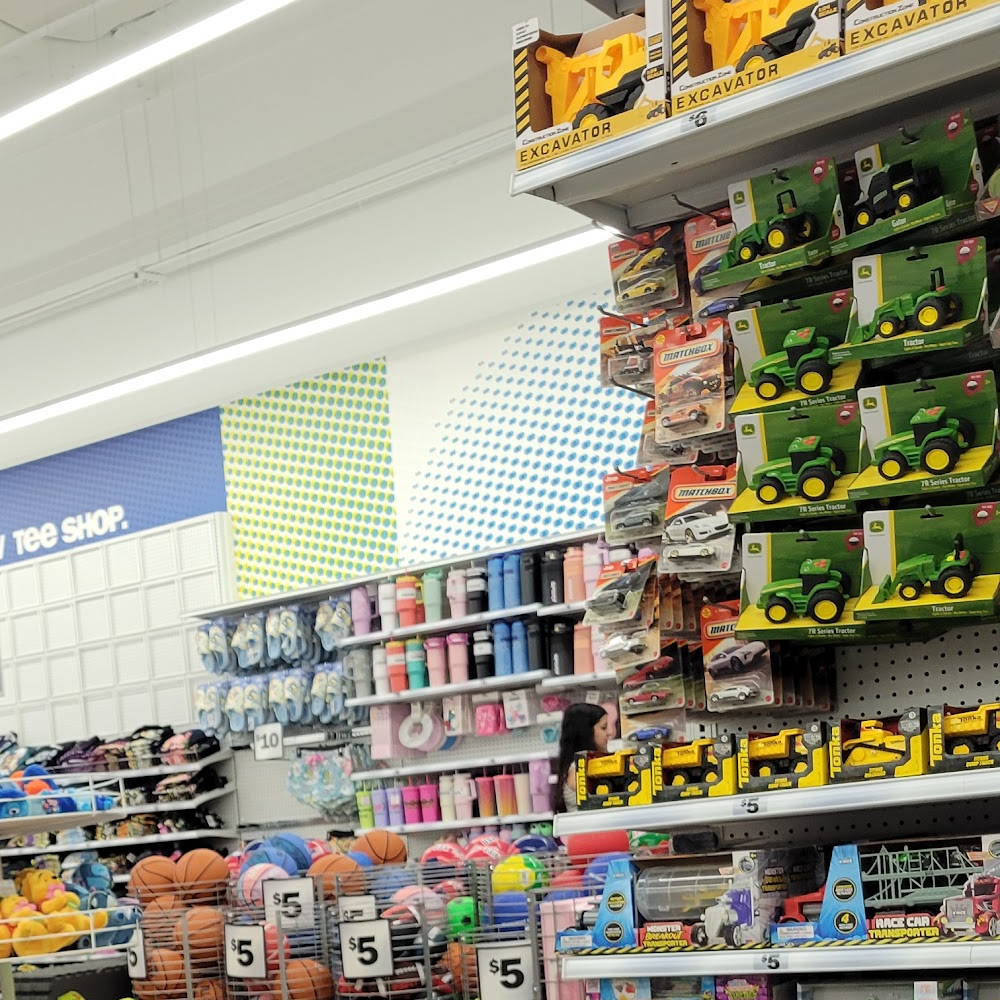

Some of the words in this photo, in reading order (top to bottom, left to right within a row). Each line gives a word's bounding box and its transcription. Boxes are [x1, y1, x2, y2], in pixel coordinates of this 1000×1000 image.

[850, 0, 967, 45] EXCAVATOR
[676, 63, 778, 110] EXCAVATOR
[688, 110, 708, 127] $6
[520, 121, 611, 163] EXCAVATOR
[695, 230, 732, 249] MATCHB
[903, 337, 925, 347] Tractor
[663, 342, 715, 362] MATCHBOX
[808, 396, 826, 406] Series
[826, 394, 847, 403] Tractor
[930, 478, 948, 487] Series
[949, 475, 971, 484] Tractor
[678, 487, 733, 497] MATCHBOX
[808, 504, 826, 512] Series
[826, 502, 847, 511] Tractor
[61, 504, 129, 543] SHOP.
[710, 624, 737, 636] MATC
[817, 627, 834, 635] Series
[835, 627, 856, 635] Tractor
[741, 798, 759, 814] $5
[273, 892, 302, 918] $5
[875, 917, 905, 928] RACE
[906, 915, 930, 926] CAR
[645, 931, 684, 940] BREAKOUT
[868, 927, 940, 939] TRANSPORTER
[348, 936, 379, 965] $5
[643, 939, 689, 948] TRANSPORTER
[231, 939, 254, 967] $5
[761, 954, 780, 970] $5
[489, 958, 525, 989] $5
